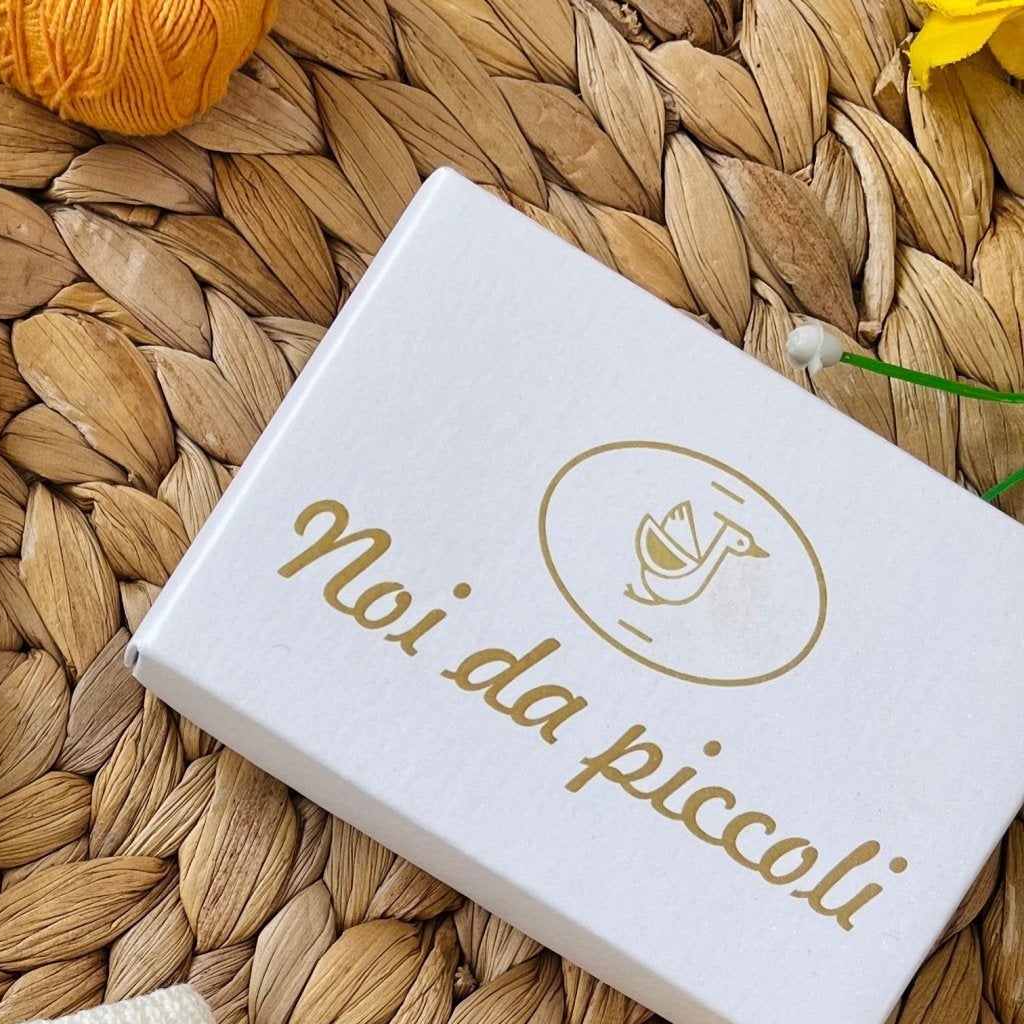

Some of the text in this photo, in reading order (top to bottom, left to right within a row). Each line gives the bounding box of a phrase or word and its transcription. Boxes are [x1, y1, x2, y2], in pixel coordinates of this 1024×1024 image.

[279, 499, 908, 931] Noi da piccoli
